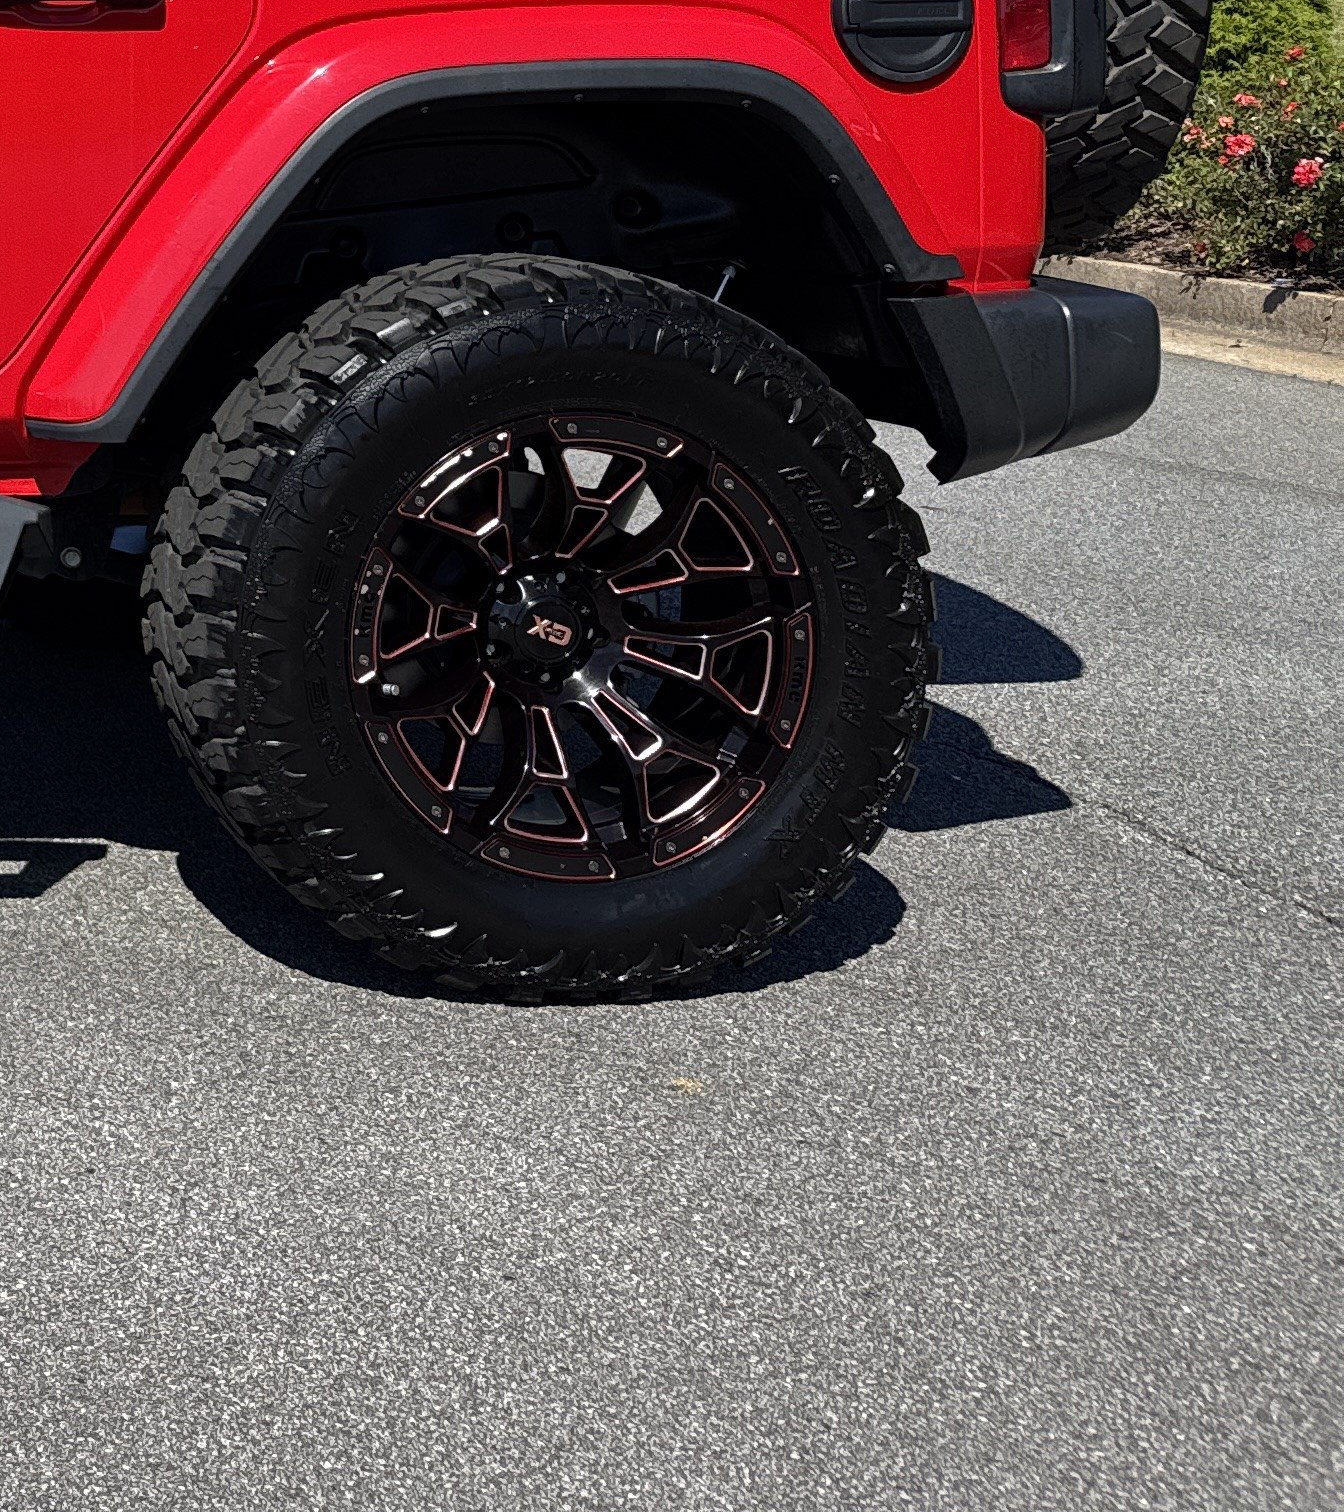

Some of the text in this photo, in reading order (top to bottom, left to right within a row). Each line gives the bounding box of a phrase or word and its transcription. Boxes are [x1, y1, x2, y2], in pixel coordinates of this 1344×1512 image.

[303, 510, 361, 778] NEXEN
[526, 614, 573, 647] XD
[776, 465, 872, 730] ROADIAN
